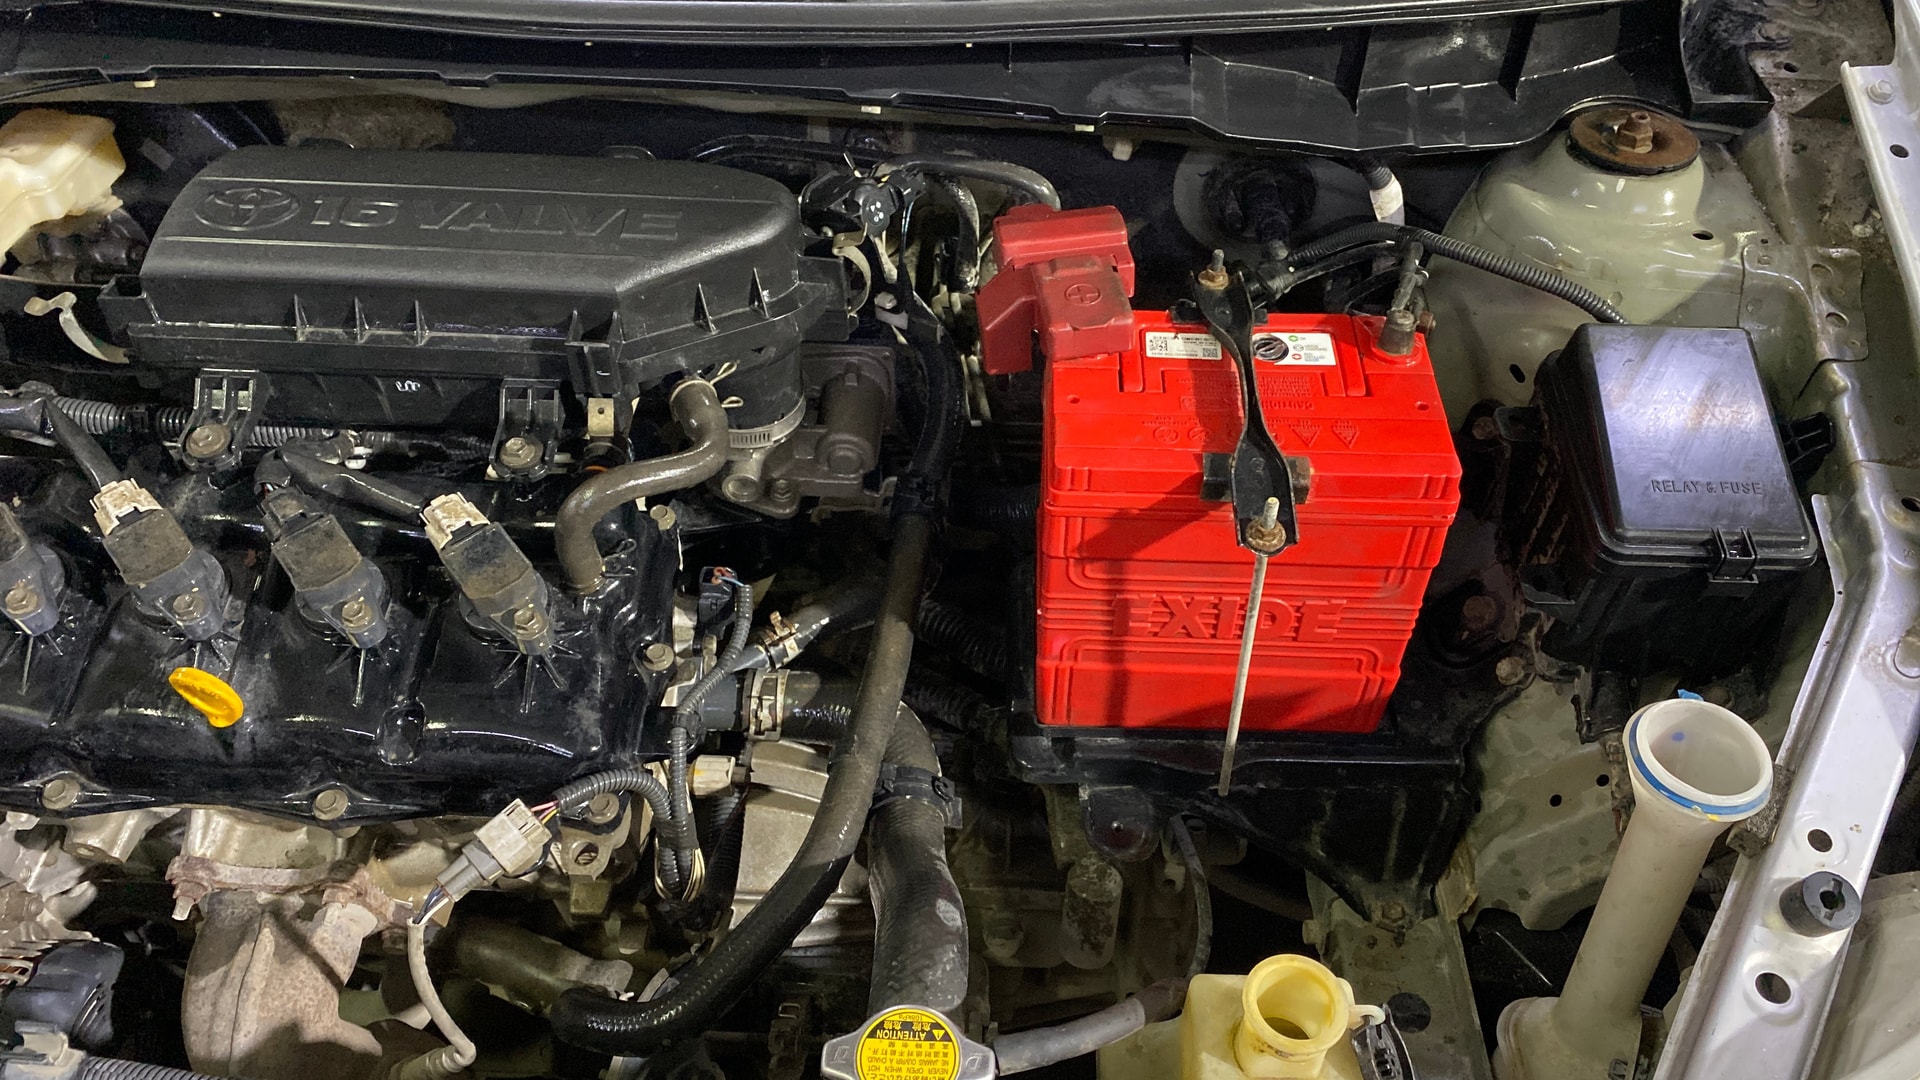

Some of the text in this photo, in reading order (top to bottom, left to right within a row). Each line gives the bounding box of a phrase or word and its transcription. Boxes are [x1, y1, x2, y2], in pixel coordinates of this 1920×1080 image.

[311, 197, 683, 241] 16 VALVE
[1651, 479, 1763, 495] RELAY & FUSE
[1110, 593, 1347, 643] EXIDE
[876, 1029, 926, 1040] ATTENTION
[919, 1059, 940, 1067] JAMAIS
[884, 1065, 905, 1074] WHEN
[906, 1066, 925, 1075] OPEN
[927, 1067, 949, 1076] NEVER
